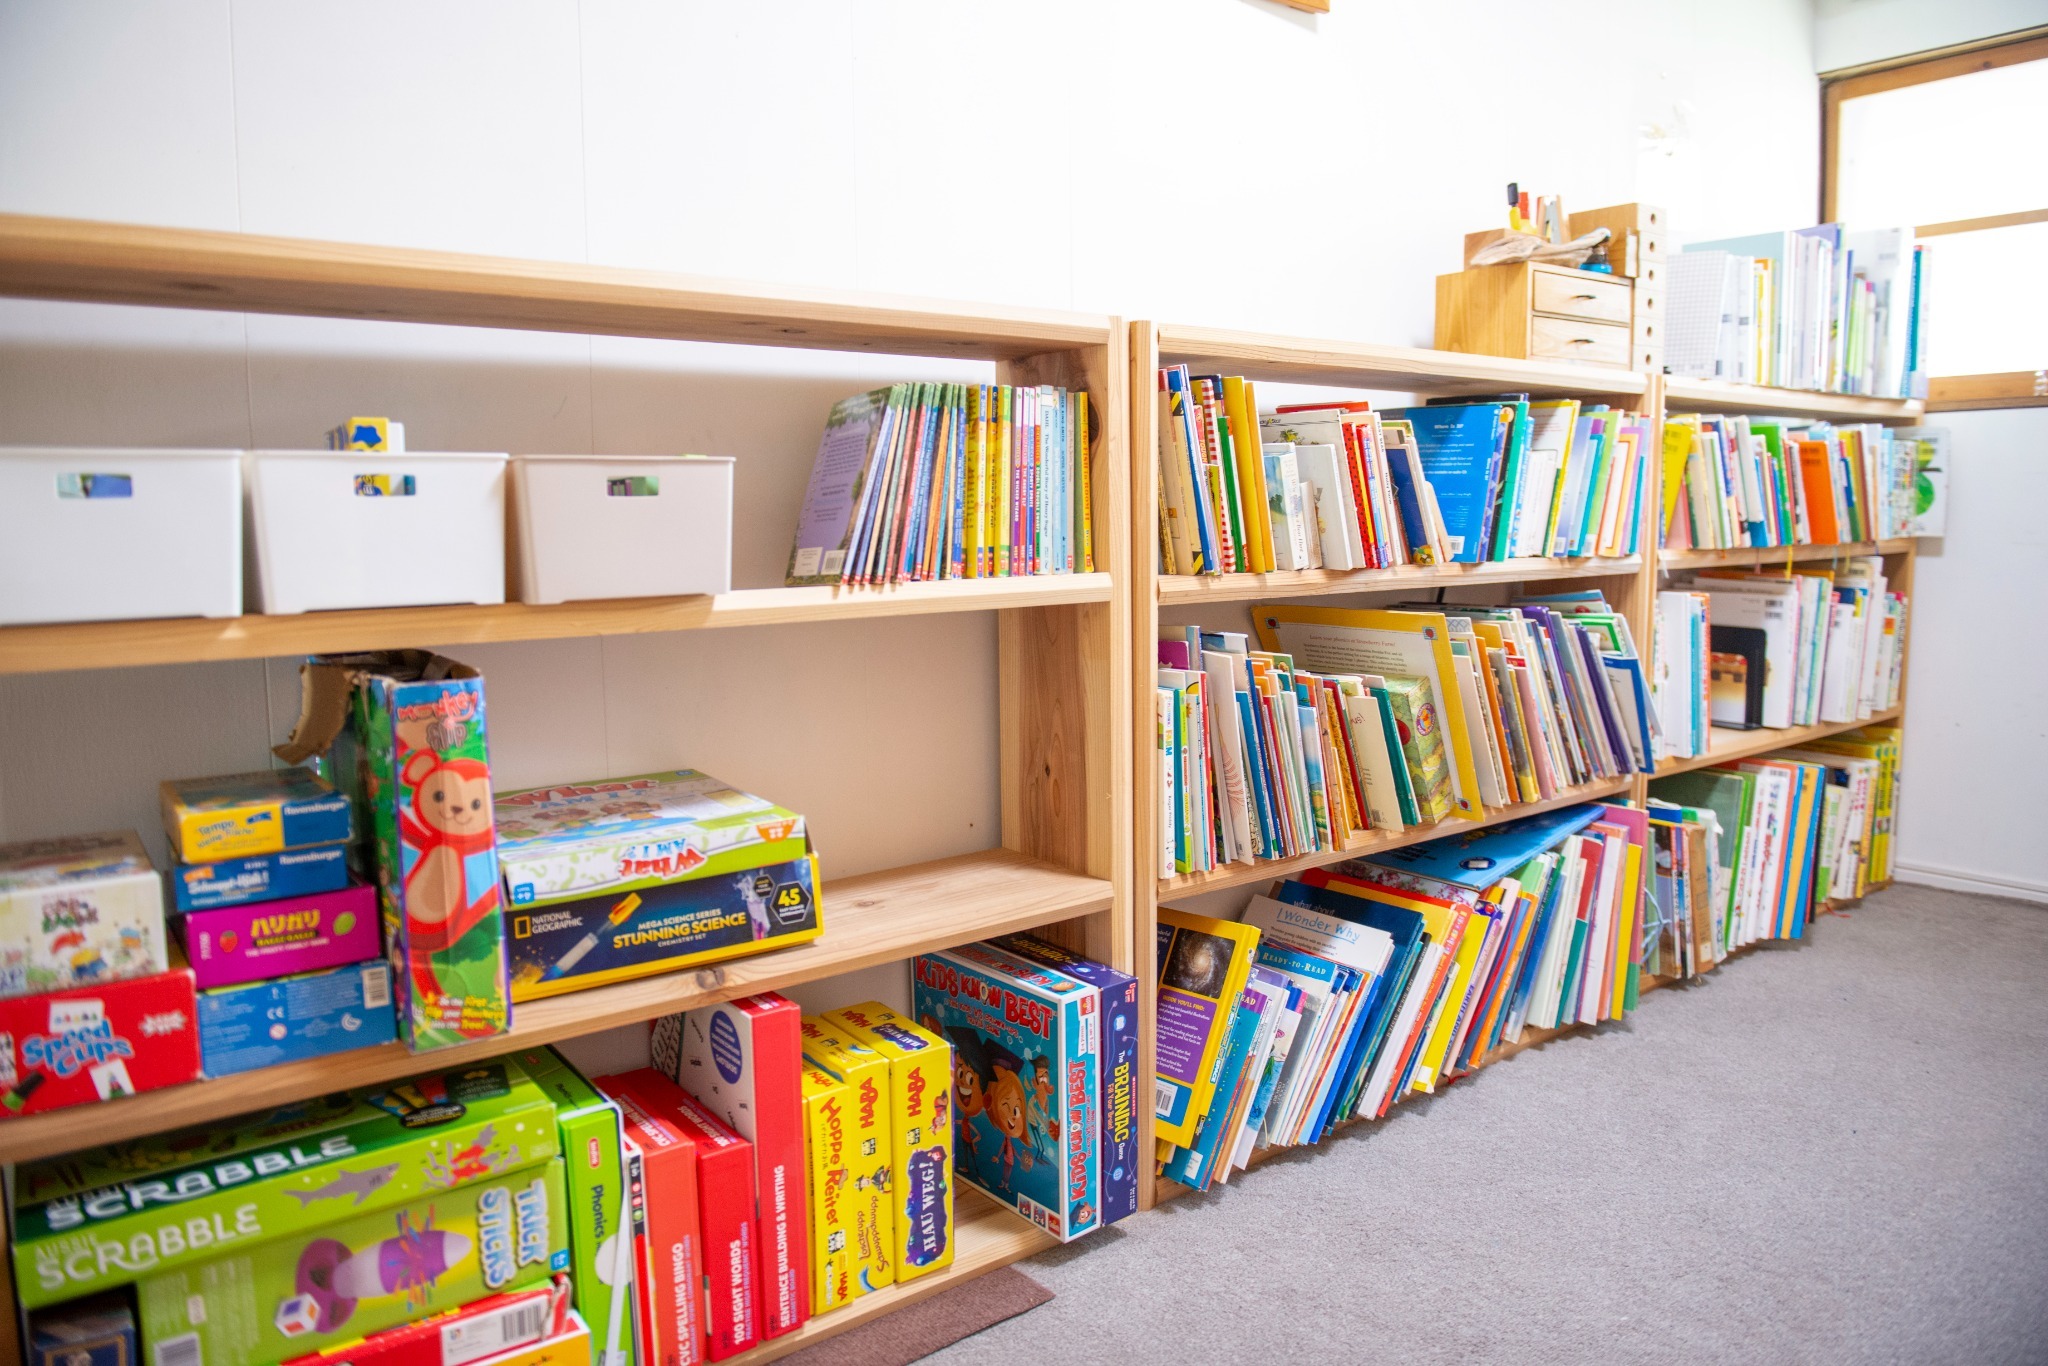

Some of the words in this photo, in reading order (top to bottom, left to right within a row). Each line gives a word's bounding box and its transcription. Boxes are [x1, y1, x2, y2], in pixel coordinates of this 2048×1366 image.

[284, 801, 346, 816] Ravensburger
[280, 851, 343, 866] Ravensburger
[620, 848, 706, 877] What
[532, 911, 571, 924] NATIONAL
[778, 888, 800, 906] 45
[532, 917, 583, 934] GEOGRAPHIC
[613, 926, 690, 949] STUNNING
[692, 912, 746, 935] SCIENCE
[638, 920, 662, 930] MEGA
[663, 914, 694, 927] SCIENCE
[696, 908, 722, 921] SERIES
[1284, 910, 1330, 932] Wonder
[1335, 923, 1360, 942] Why
[658, 936, 693, 948] CHEMISTRY
[960, 972, 1002, 1009] KNOW
[1004, 990, 1053, 1039] BEST
[1241, 994, 1256, 1005] EAD
[1464, 985, 1475, 1012] EARTH
[23, 1018, 113, 1066] Speed
[54, 1039, 132, 1076] Cups
[1068, 1060, 1086, 1108] BEST
[1209, 1058, 1222, 1083] SPACE
[859, 1076, 878, 1129] HABA
[907, 1066, 926, 1118] HABA
[1114, 1062, 1130, 1143] BRAINIAC
[820, 1096, 842, 1166] Hoppe
[1068, 1110, 1083, 1152] KNOW
[46, 1135, 357, 1231] SCRABBLE
[774, 1164, 785, 1213] WRITING
[824, 1169, 845, 1226] Reiter
[920, 1162, 935, 1210] WEG!
[515, 1178, 548, 1266] TRICK
[592, 1184, 608, 1239] Phonics
[776, 1212, 786, 1226] &
[35, 1203, 264, 1291] SCRABBLE
[479, 1187, 514, 1287] STICKS
[776, 1226, 788, 1274] BUILDING
[921, 1213, 937, 1252] HAU
[672, 1242, 685, 1283] BINGO
[730, 1240, 742, 1286] WORDS
[732, 1288, 744, 1323] SIGHT
[778, 1273, 790, 1328] SENTENCE
[837, 1270, 848, 1302] HABA
[674, 1284, 690, 1340] SPELLING
[679, 1341, 691, 1366] CVC
[734, 1324, 745, 1345] 100
